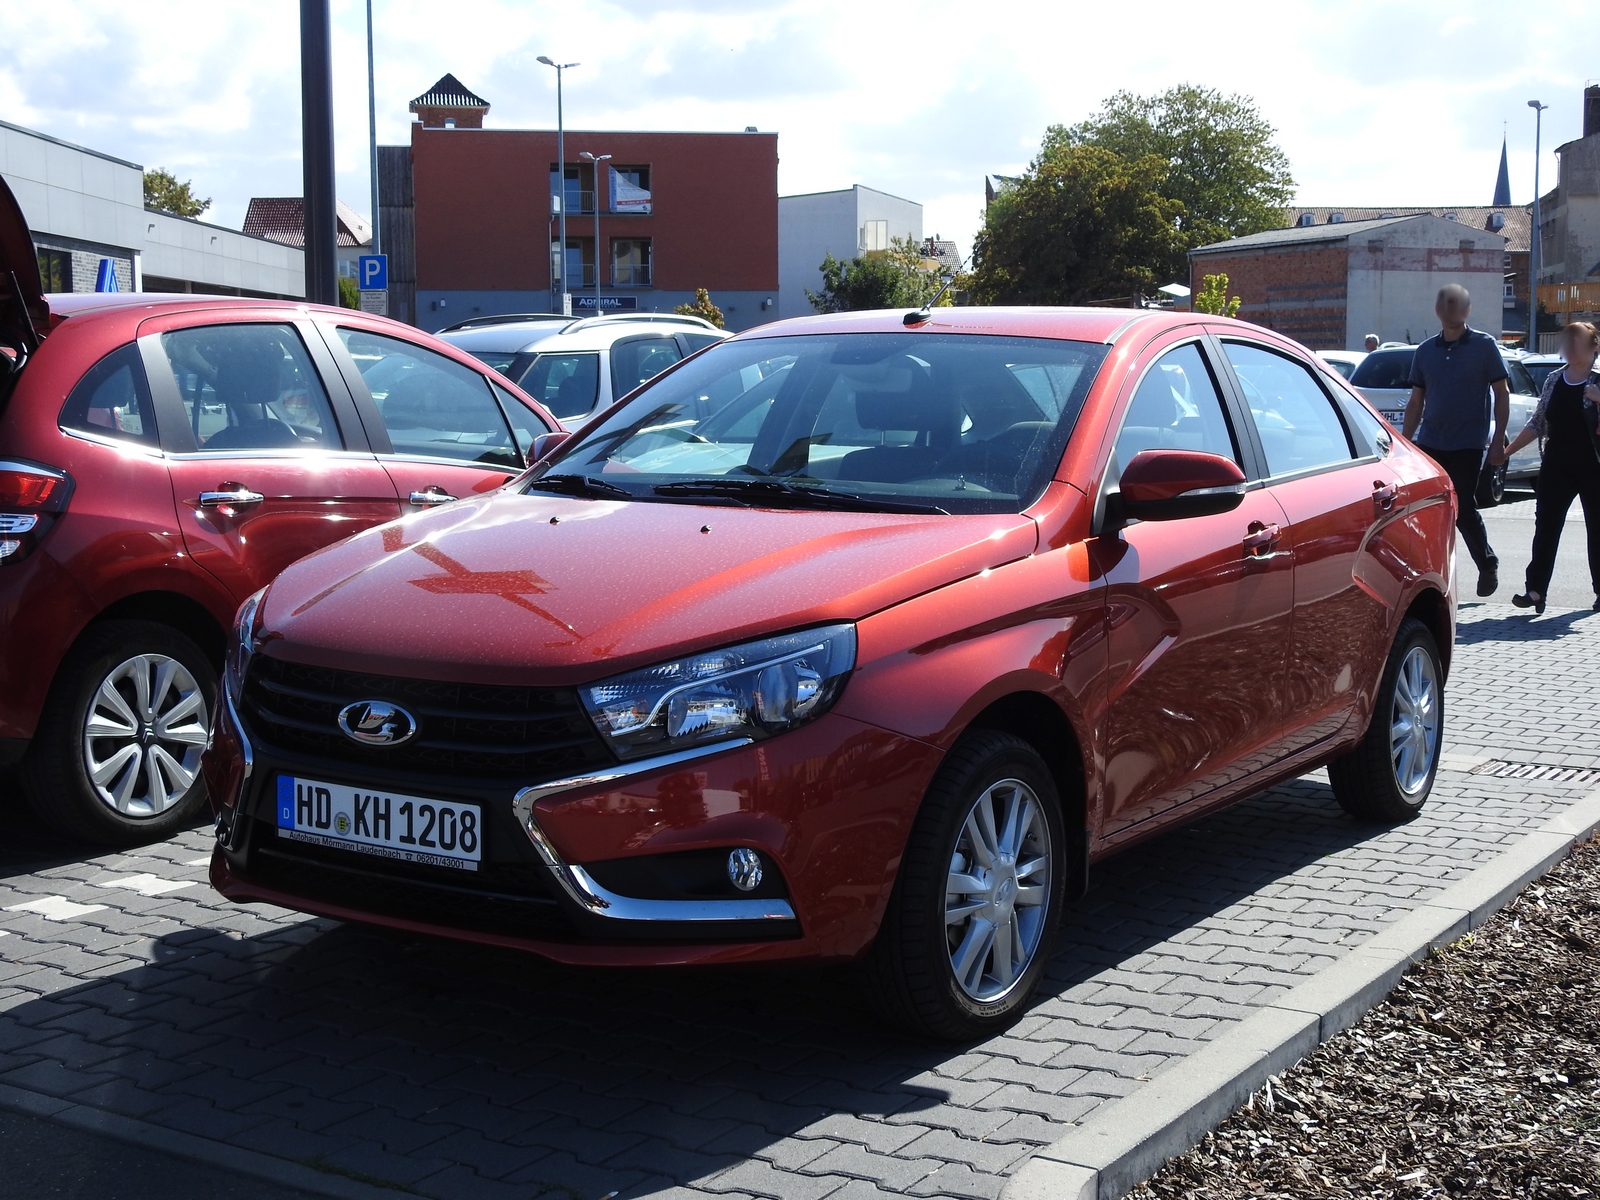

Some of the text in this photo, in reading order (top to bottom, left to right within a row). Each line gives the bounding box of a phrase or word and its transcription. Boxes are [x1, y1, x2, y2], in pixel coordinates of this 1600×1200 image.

[365, 260, 381, 286] P
[283, 807, 290, 819] D
[297, 784, 477, 853] HD KH 1208
[289, 832, 465, 869] Autohaus Mörmann Laudenbach 06201/43001
